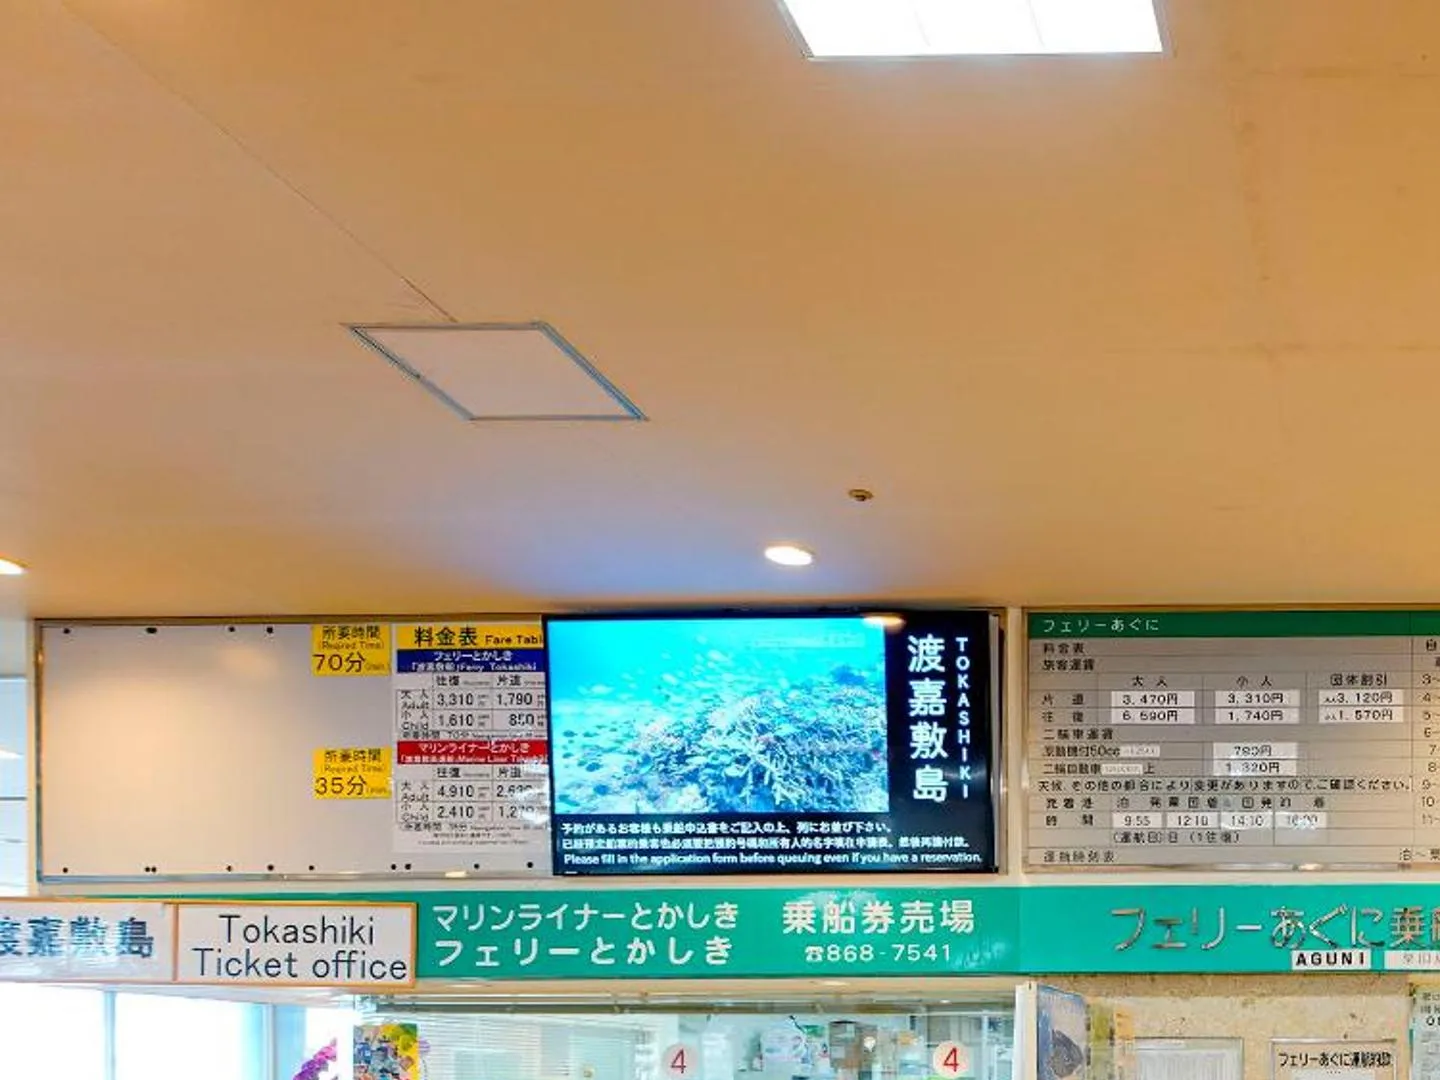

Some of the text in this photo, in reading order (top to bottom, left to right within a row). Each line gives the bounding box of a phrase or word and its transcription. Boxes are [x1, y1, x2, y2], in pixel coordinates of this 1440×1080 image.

[414, 627, 543, 646] 料金表 Fare Tabl
[1043, 618, 1160, 634] フェリーあぐに
[312, 651, 366, 673] 70分
[907, 633, 948, 803] 渡嘉敷島
[955, 637, 971, 799] TOKASHIKI
[316, 775, 367, 796] 35分
[564, 854, 599, 864] Please
[601, 853, 615, 863] fill
[617, 853, 627, 863] in
[630, 853, 648, 863] the
[650, 853, 711, 866] application
[712, 852, 737, 863] form
[739, 852, 775, 863] before
[777, 853, 821, 865] queuing
[824, 853, 849, 863] even
[883, 852, 908, 862] have
[920, 852, 982, 863] reservation.
[219, 914, 375, 945] Tokashiki
[433, 900, 975, 934] マリンライナーとかしき 乗船券売場
[192, 947, 407, 980] Ticket office
[435, 936, 952, 967] フェリーとかしき 868-7541
[1296, 951, 1366, 967] AGUNI
[671, 1048, 687, 1074] 4
[943, 1047, 960, 1072] 4
